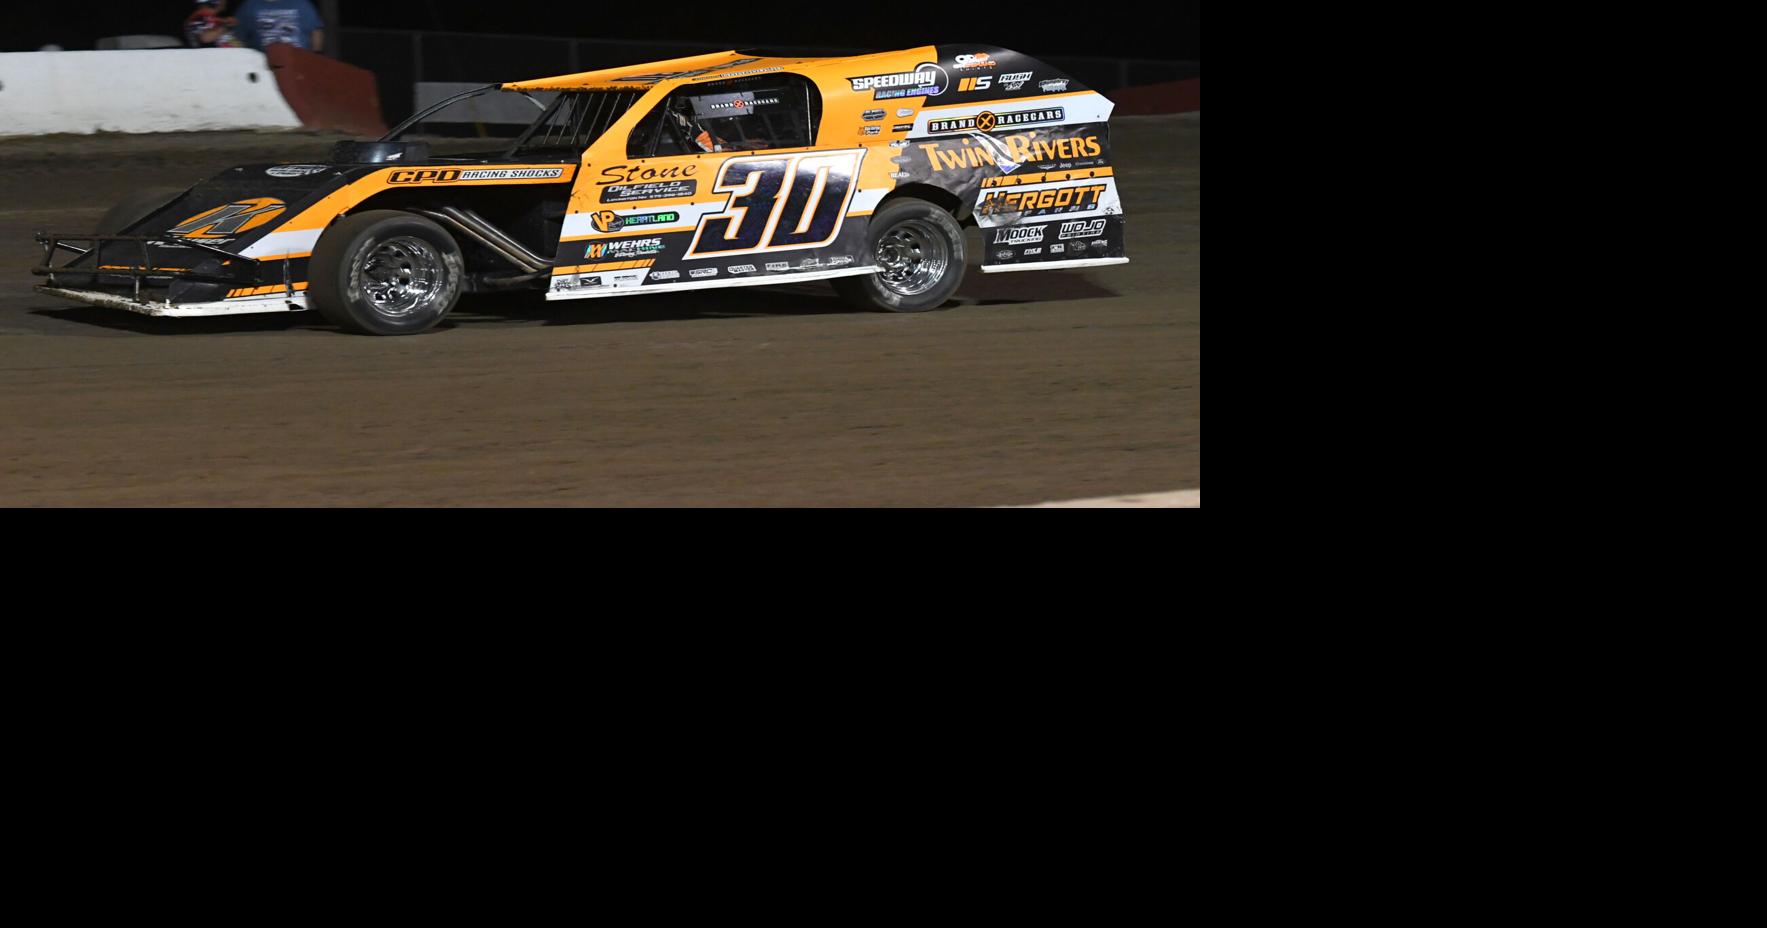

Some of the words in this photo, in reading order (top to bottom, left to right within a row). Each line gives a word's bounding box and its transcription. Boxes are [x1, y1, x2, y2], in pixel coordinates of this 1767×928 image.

[851, 71, 937, 90] SPEEDWAY
[875, 89, 906, 99] RACING
[906, 86, 940, 97] ENGINES
[931, 121, 975, 132] BRAND
[998, 109, 1062, 125] RACECARS
[387, 168, 462, 185] CPD
[462, 170, 507, 180] RACING
[509, 168, 561, 179] SHOCKS
[596, 164, 697, 186] Stone
[620, 185, 691, 197] SERVICE
[682, 148, 868, 261] 30
[591, 209, 616, 233] VP
[625, 213, 676, 225] HEARTLAND
[1061, 220, 1105, 233] WOJO
[608, 237, 663, 250] WEHRS
[994, 225, 1046, 244] MOOCK
